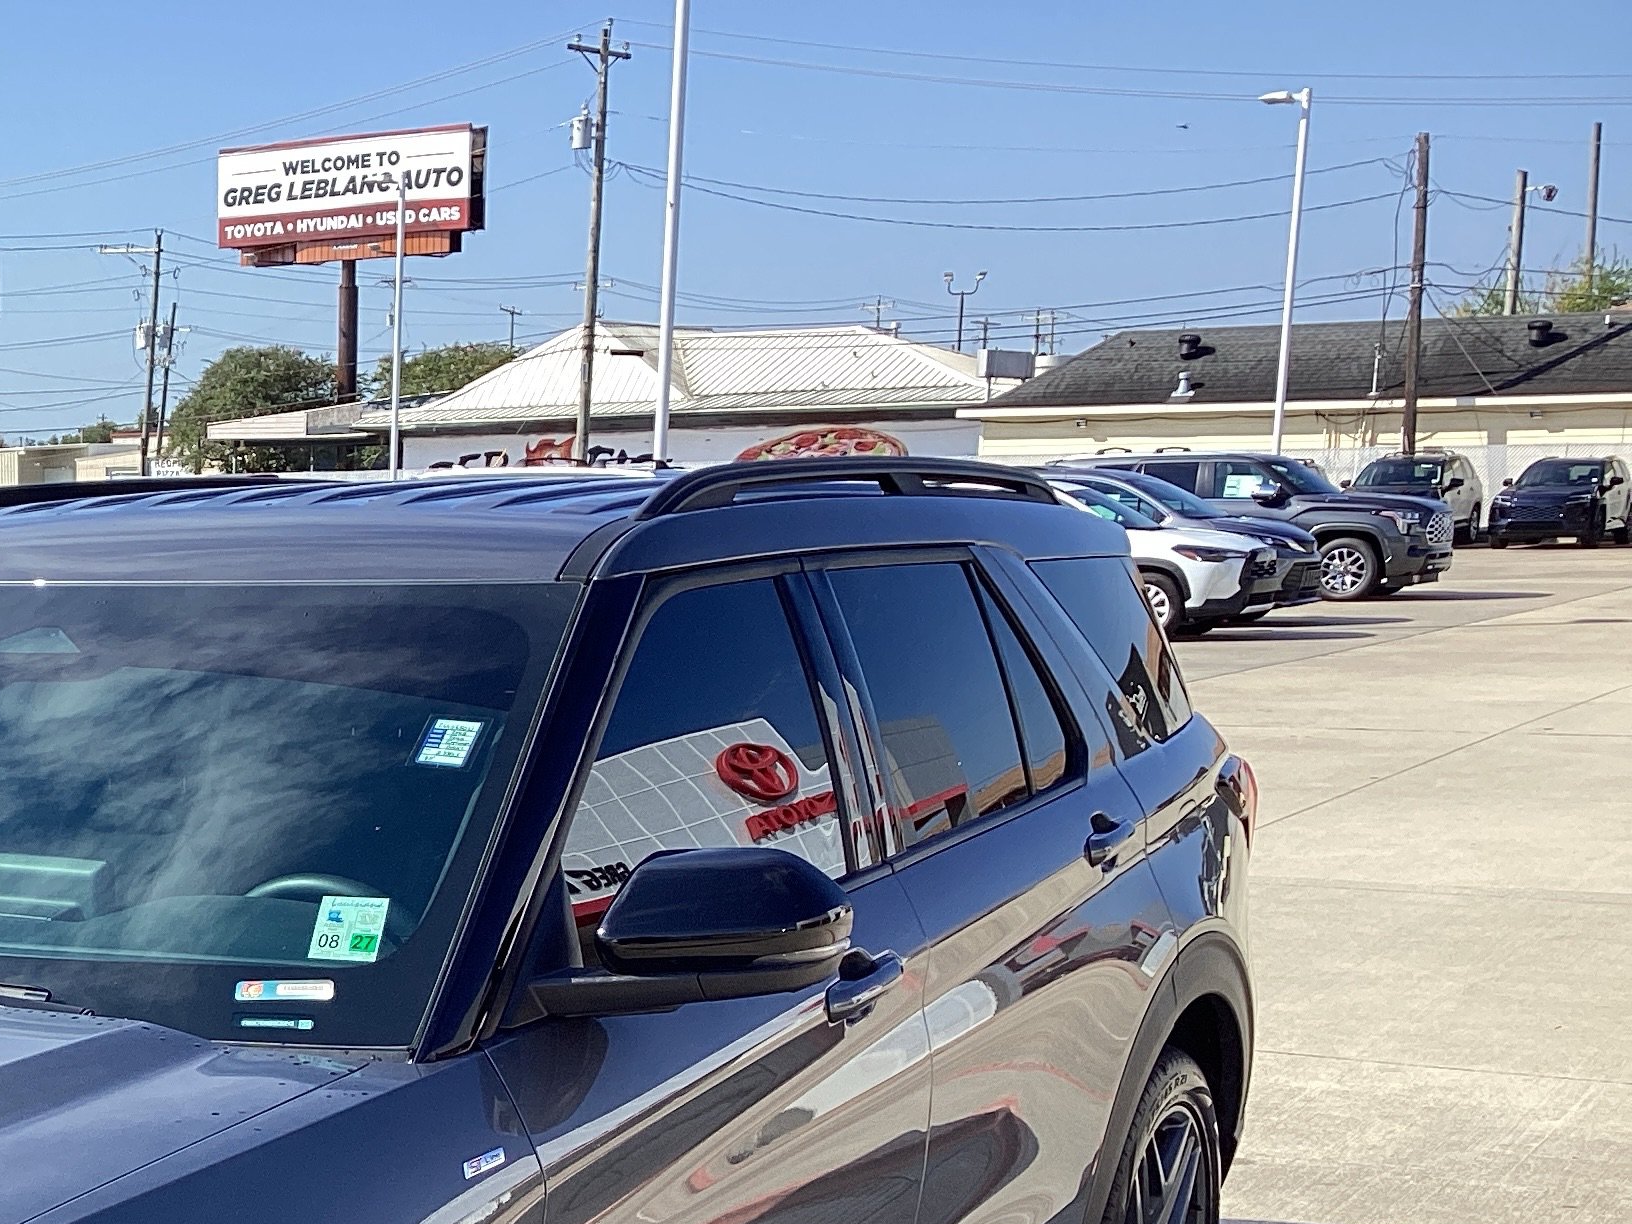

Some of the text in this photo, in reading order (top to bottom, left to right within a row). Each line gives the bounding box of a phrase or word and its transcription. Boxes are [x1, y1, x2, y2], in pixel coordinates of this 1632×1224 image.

[283, 151, 400, 176] WELCOME TO
[224, 183, 282, 207] GREG
[396, 166, 464, 190] AUTO
[225, 206, 461, 240] TOYOTA HYUNDAI USD CARS
[318, 933, 375, 950] 08 27
